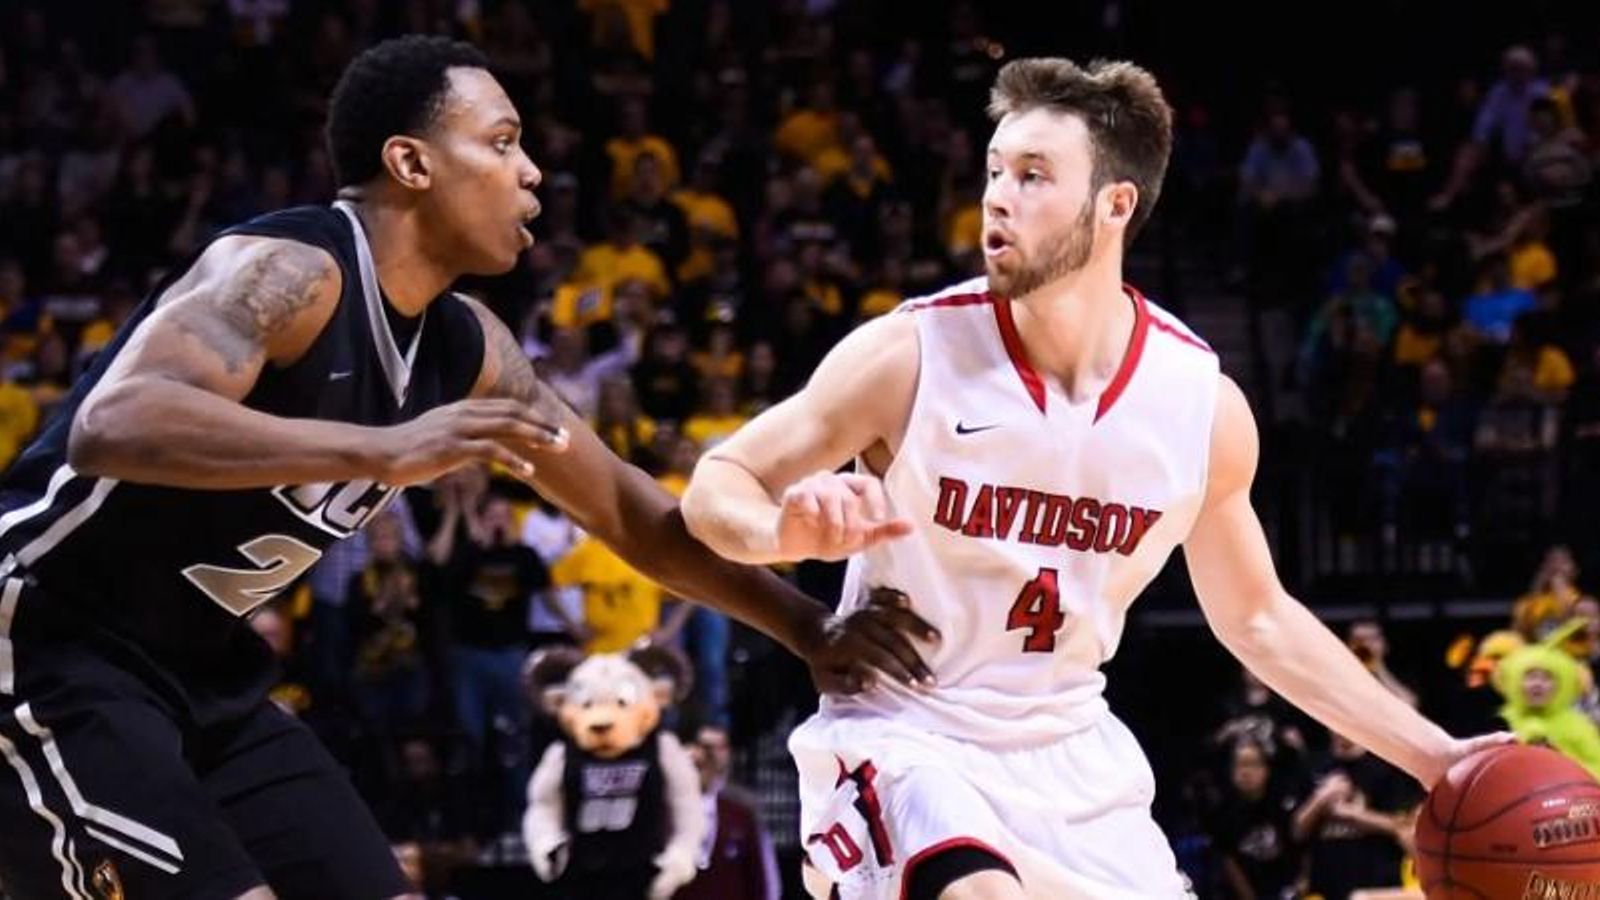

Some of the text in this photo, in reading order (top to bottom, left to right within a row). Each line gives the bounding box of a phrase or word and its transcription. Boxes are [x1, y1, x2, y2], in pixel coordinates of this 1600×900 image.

[934, 476, 1163, 556] DAVIDSON
[181, 534, 322, 617] 2
[1006, 567, 1065, 653] 4
